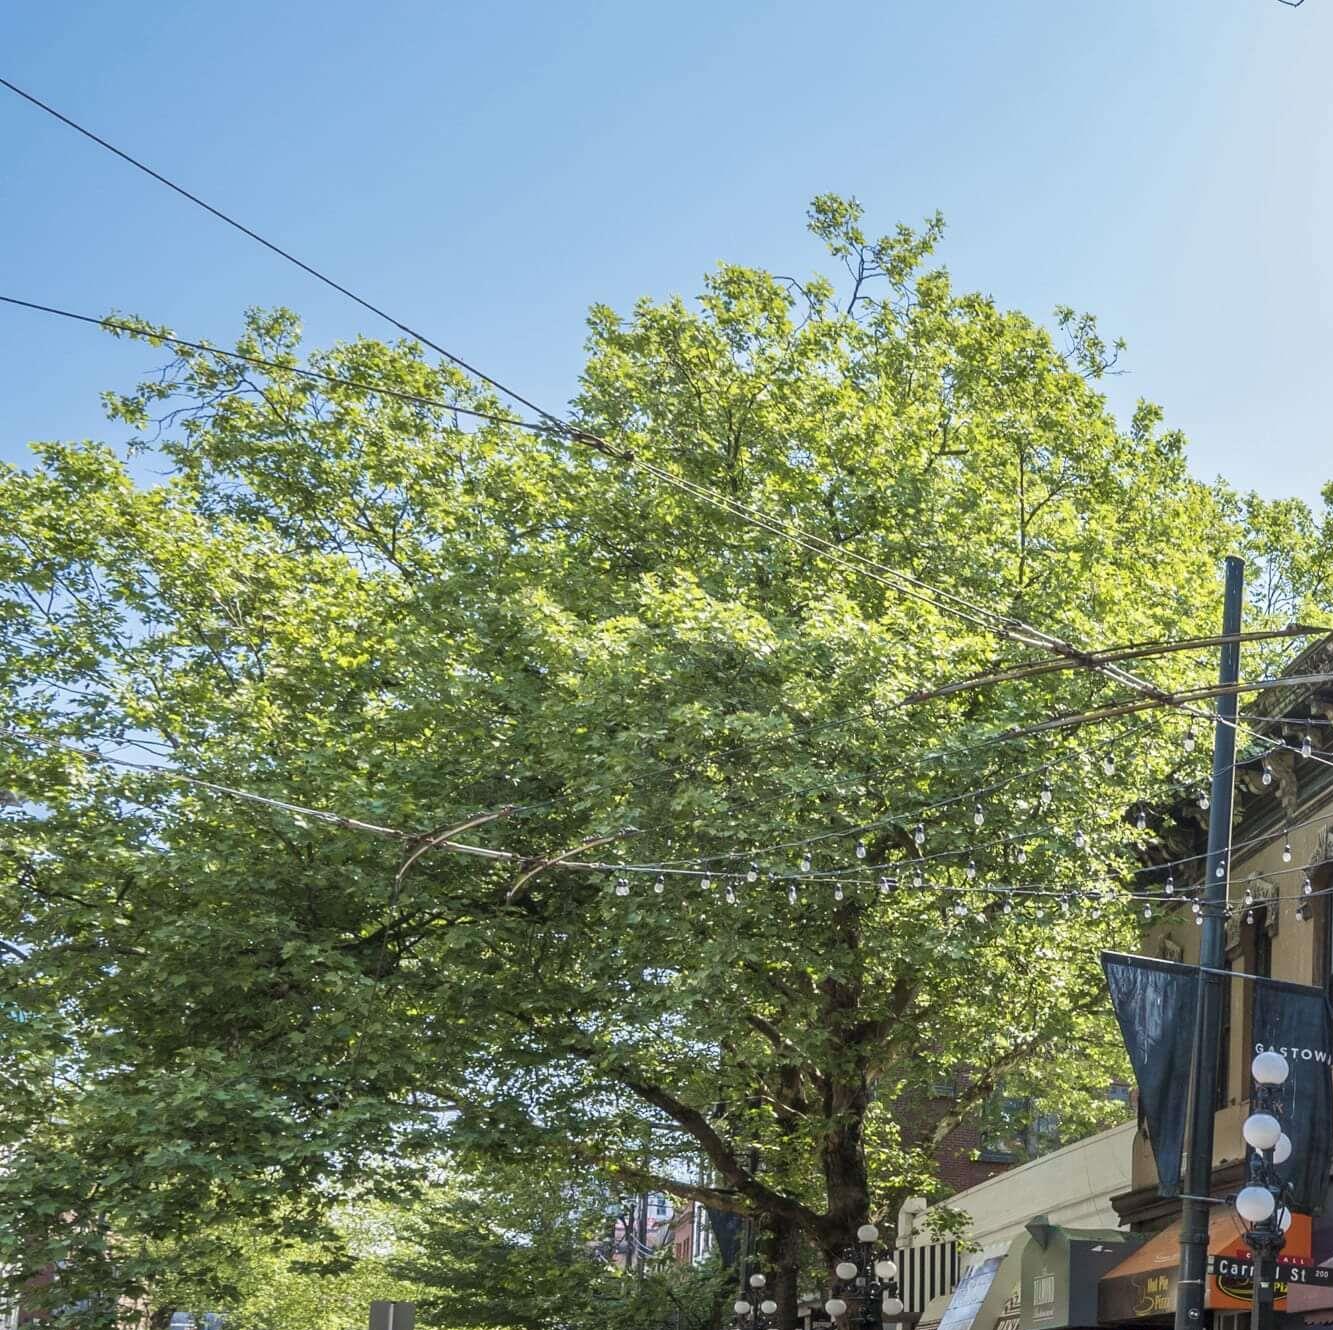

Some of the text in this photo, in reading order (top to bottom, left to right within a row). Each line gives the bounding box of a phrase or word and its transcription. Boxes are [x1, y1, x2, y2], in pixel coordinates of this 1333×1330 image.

[1219, 1260, 1329, 1282] Carrl St 200
